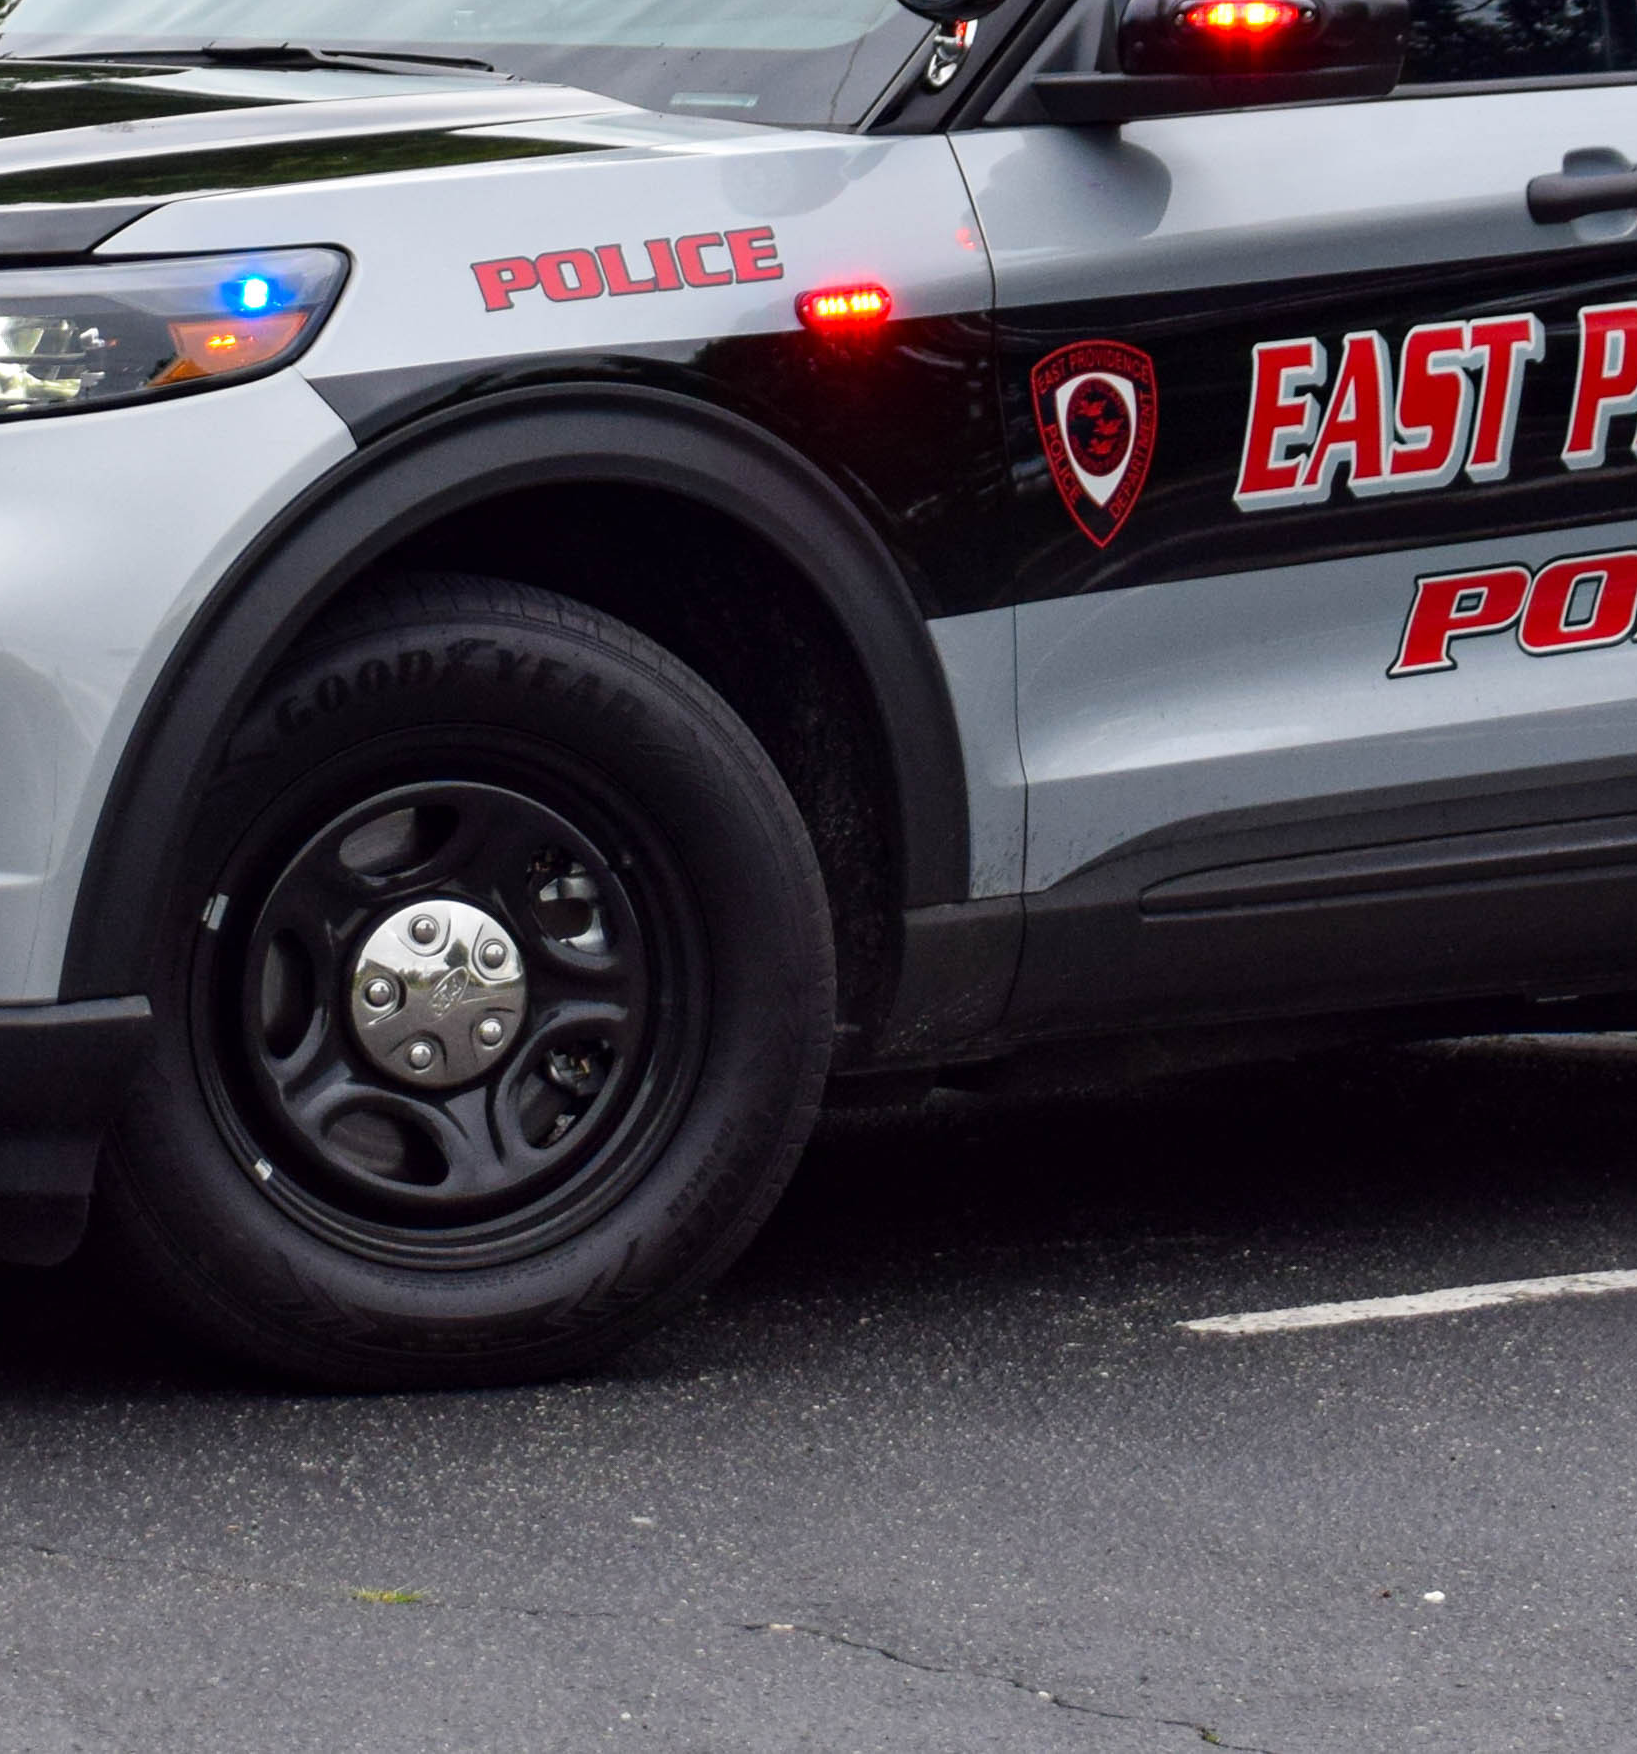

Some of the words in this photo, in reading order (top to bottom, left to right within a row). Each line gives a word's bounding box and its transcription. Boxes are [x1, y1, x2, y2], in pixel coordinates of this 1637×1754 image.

[470, 225, 784, 312] POLICE
[1036, 357, 1066, 394] EAST
[1069, 348, 1150, 383] PROVIDENCE
[1232, 312, 1546, 513] EAST
[1043, 423, 1083, 504] POLICE
[1108, 389, 1152, 519] DEPARTMENT
